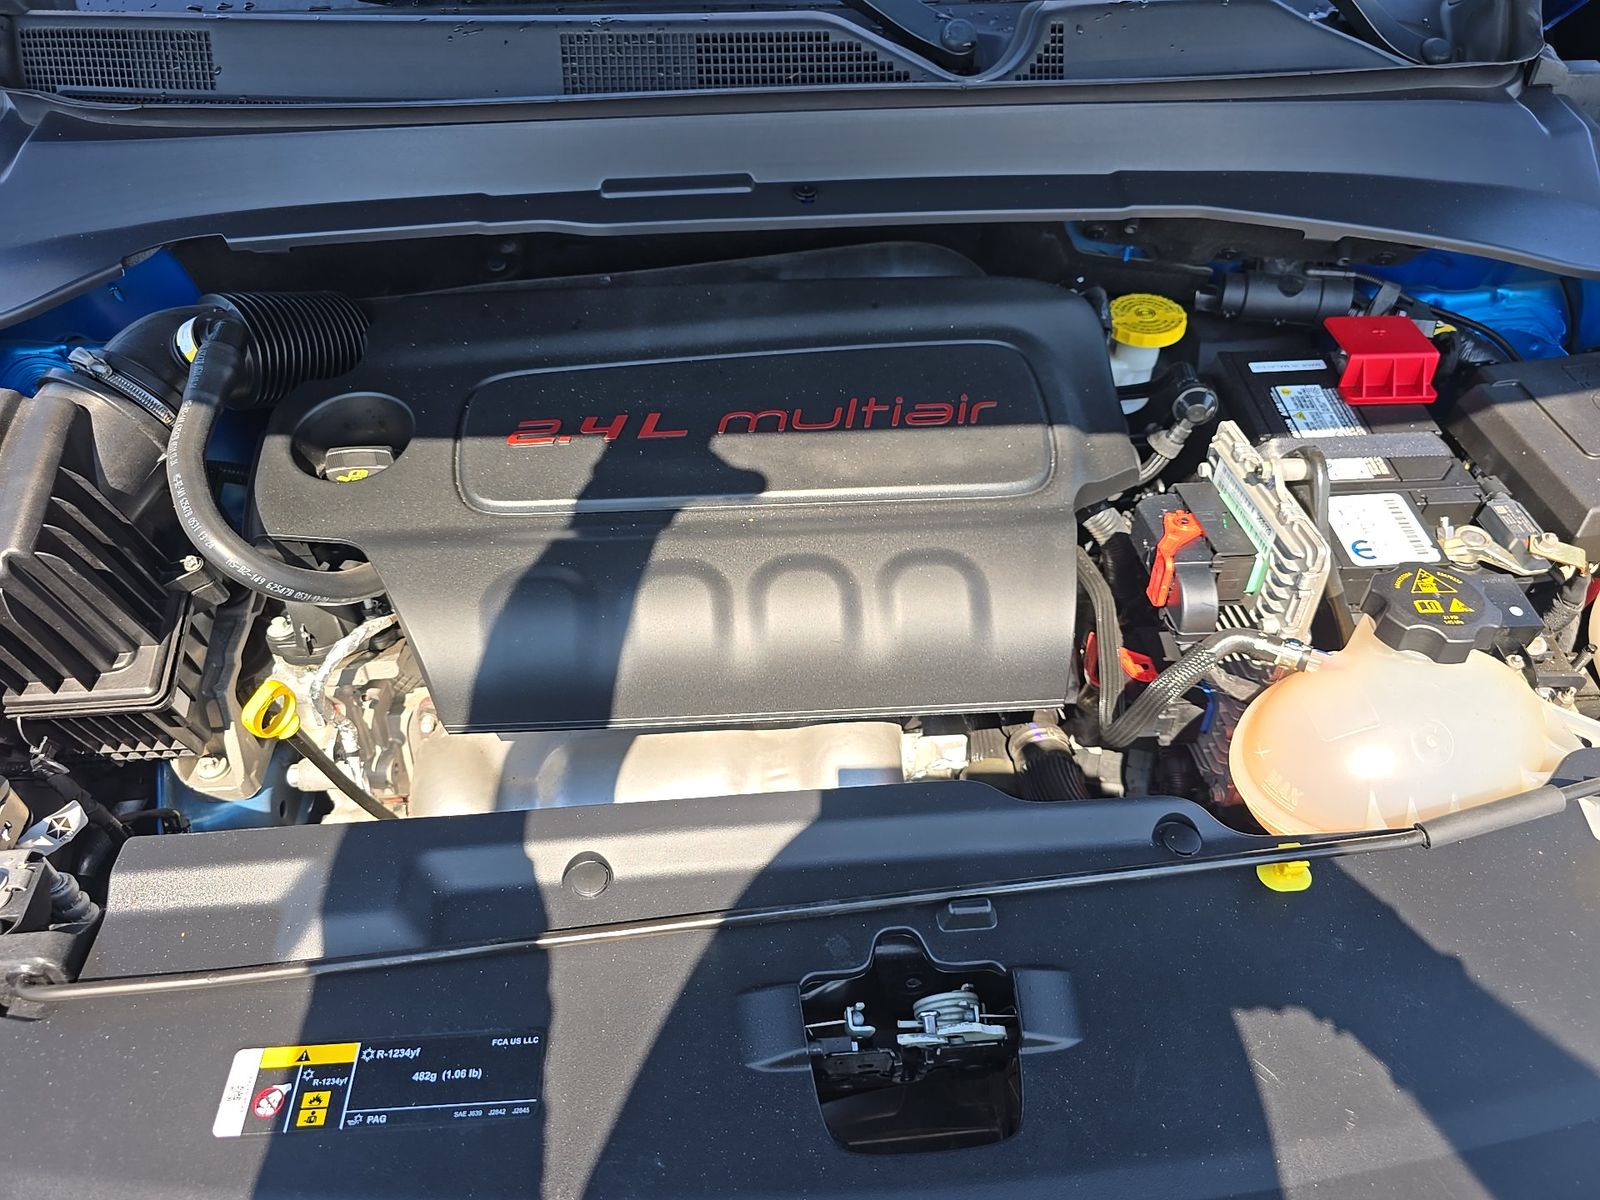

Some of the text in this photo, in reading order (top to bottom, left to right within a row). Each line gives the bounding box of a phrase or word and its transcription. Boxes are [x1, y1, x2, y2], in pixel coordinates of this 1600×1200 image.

[717, 393, 998, 434] multiair
[492, 1036, 539, 1047] FCA US LLC
[376, 1047, 421, 1060] R-1234yf
[411, 1068, 482, 1083] 482g (1.06 lb)
[312, 1077, 349, 1087] R-1234yf
[366, 1115, 387, 1124] PAG
